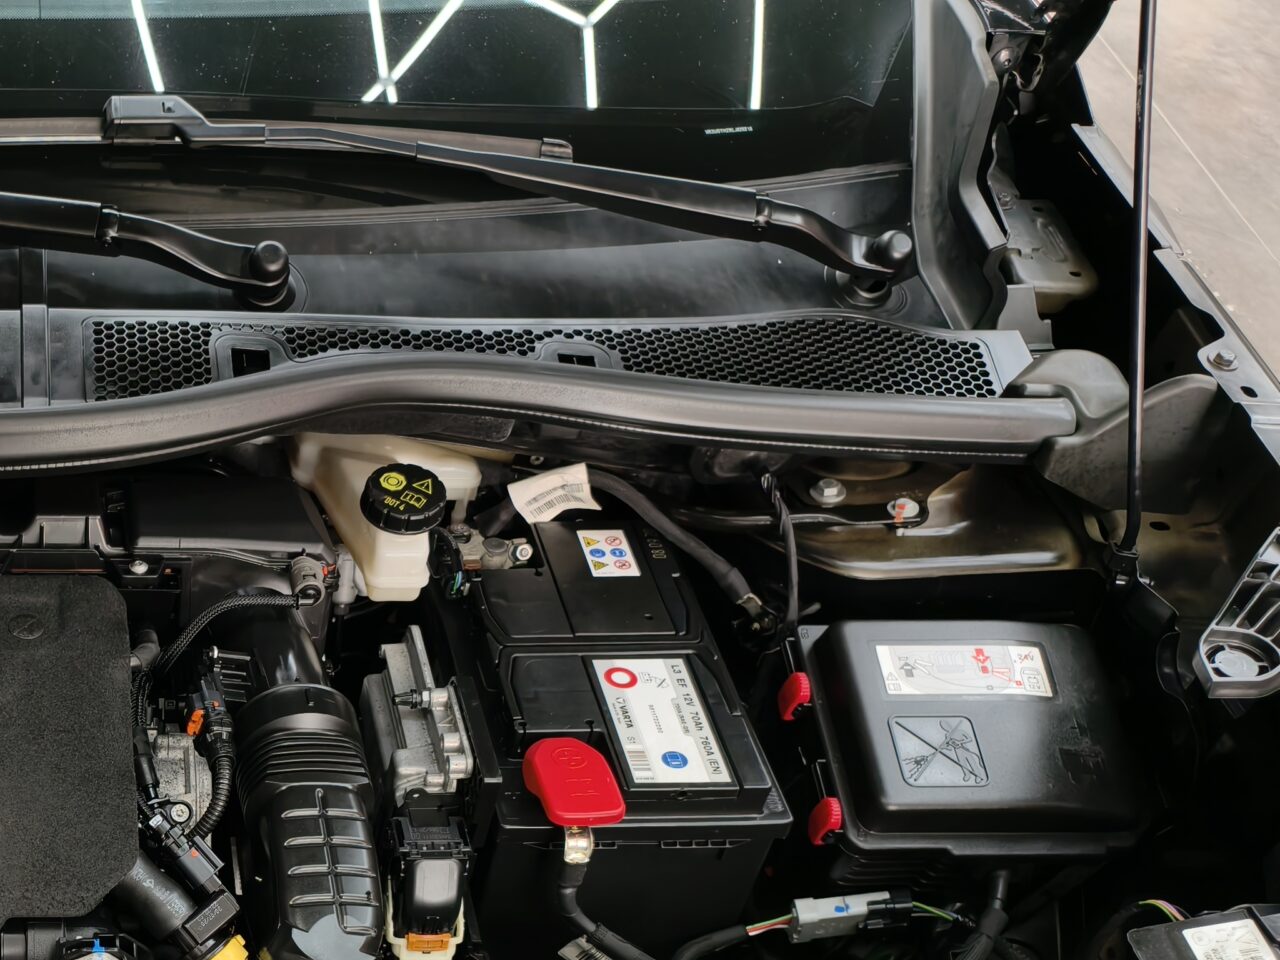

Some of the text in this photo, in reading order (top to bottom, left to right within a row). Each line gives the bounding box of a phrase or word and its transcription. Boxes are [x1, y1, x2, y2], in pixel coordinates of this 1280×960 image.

[385, 497, 401, 507] DOT
[671, 664, 682, 674] L3
[676, 678, 687, 689] EF
[682, 692, 695, 707] 12V
[619, 704, 634, 729] VARTA
[689, 711, 705, 731] 70Ah
[699, 736, 715, 756] 760A
[707, 758, 723, 775] (EN)
